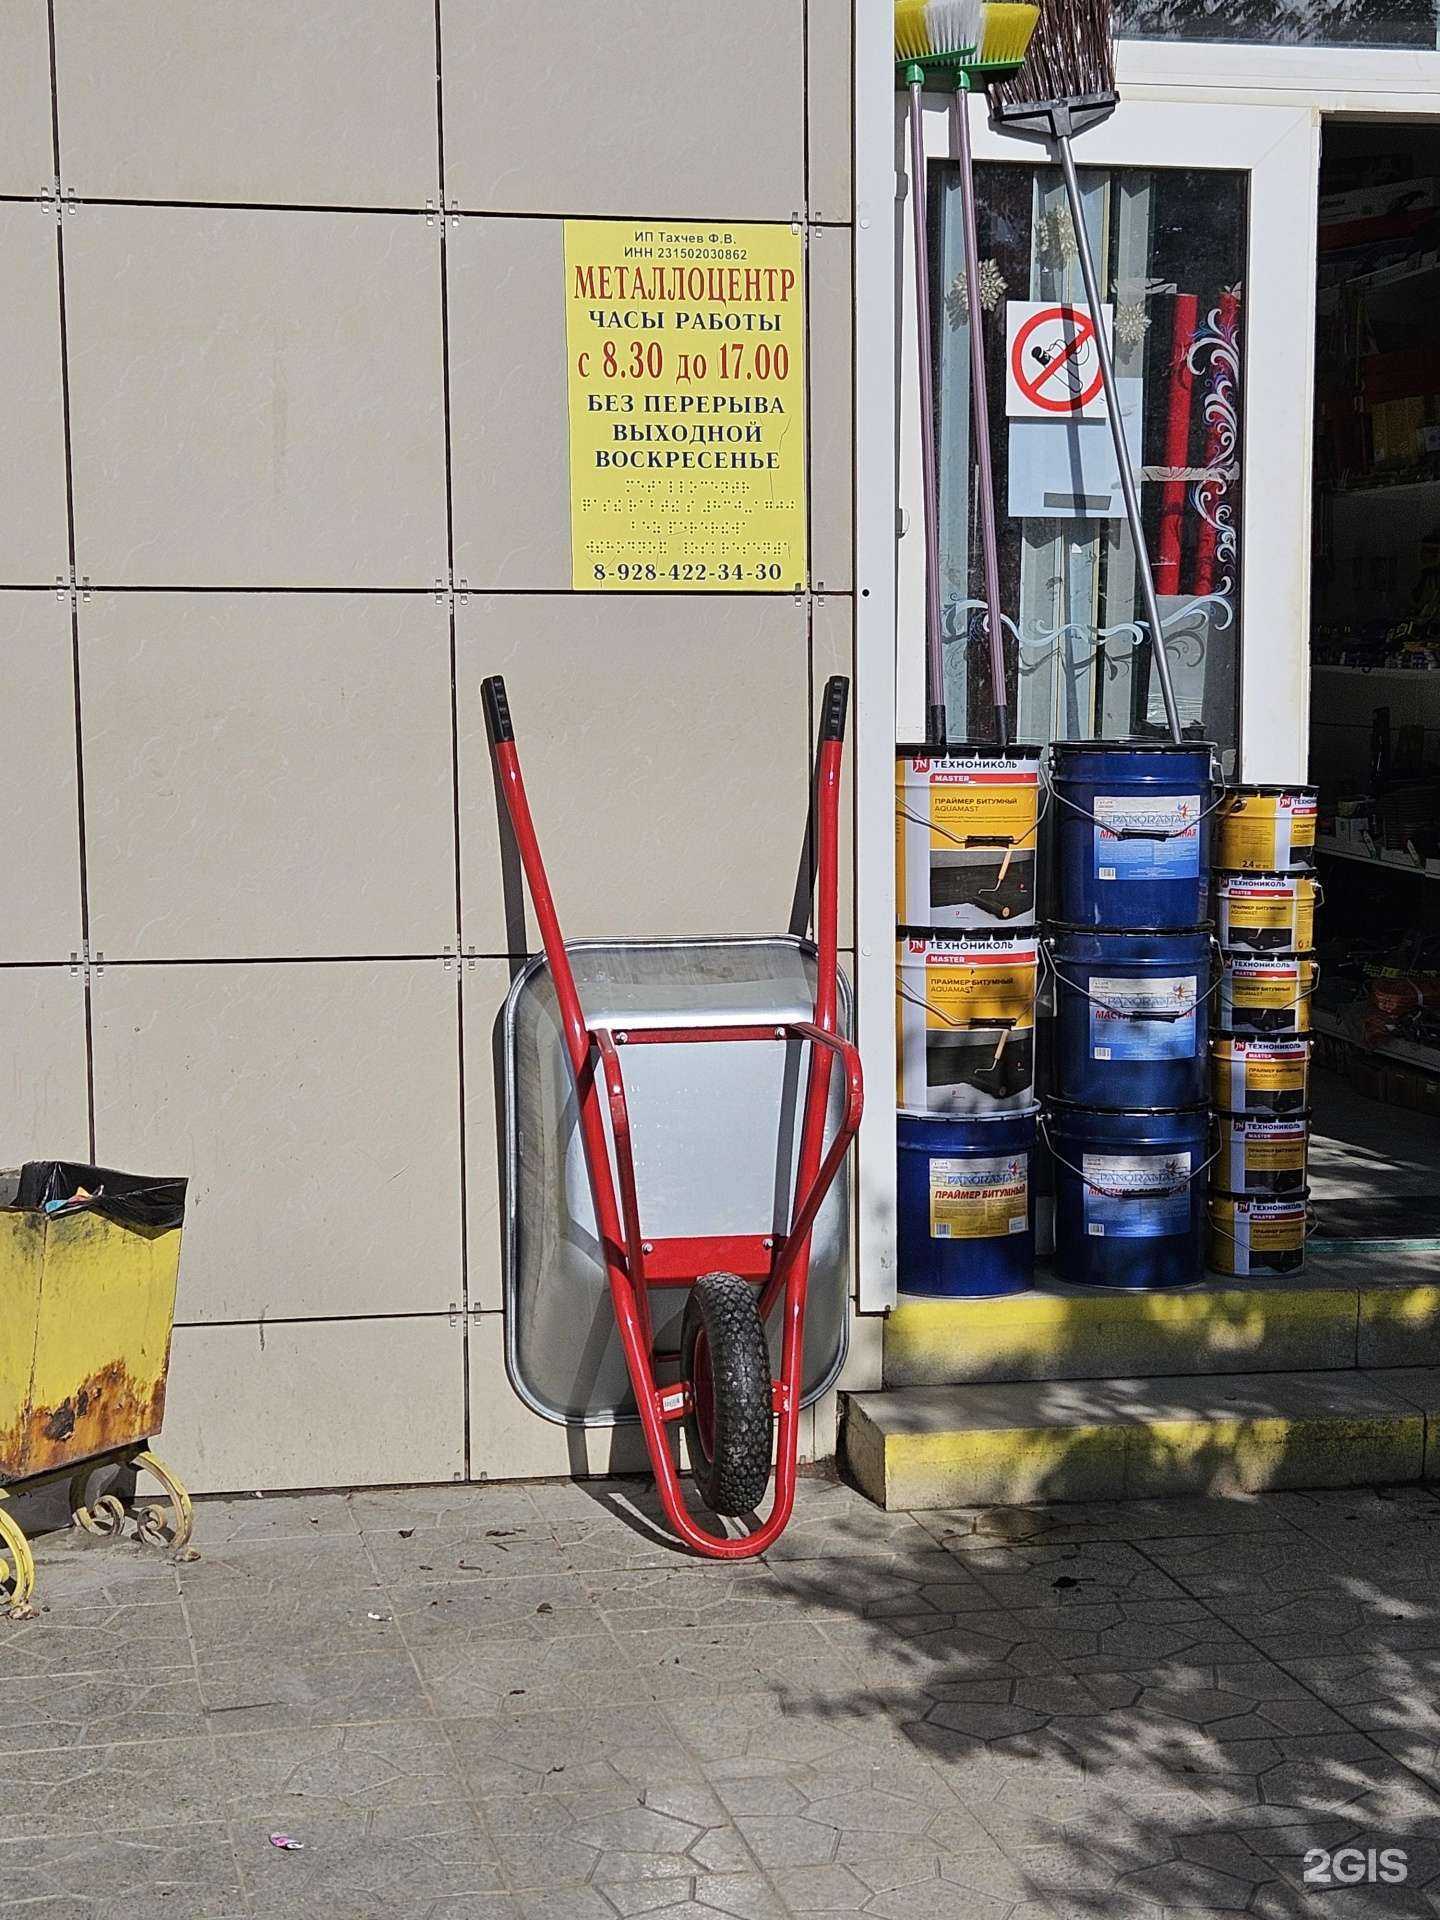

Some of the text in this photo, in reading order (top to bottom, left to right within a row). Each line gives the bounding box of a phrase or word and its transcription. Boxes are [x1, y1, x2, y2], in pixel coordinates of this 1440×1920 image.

[634, 231, 736, 245] ИП Тахчев Ф.В.
[624, 247, 747, 260] ИНН 231502030862
[574, 265, 795, 308] МЕТАЛЛОЦЕНТР
[589, 310, 781, 331] ЧАСЫ РАБОТЫ
[603, 341, 663, 378] 8.30
[676, 354, 707, 385] до
[720, 343, 789, 380] 17.00
[588, 395, 785, 414] БЕЗ ПЕРЕРЫВА
[613, 421, 762, 445] ВЫХОДНОЙ
[595, 451, 780, 469] ВОСКРЕСЕНЬЕ
[594, 564, 782, 581] 8-928-422-34-30
[933, 760, 1018, 769] ТЕХНОНИКОЛЬ
[929, 941, 1014, 950] ТЕХНОНИКОЛЬ
[931, 955, 966, 963] MASTER
[935, 1184, 1025, 1199] ПРАЙМЕР БИТУМНЫЙ
